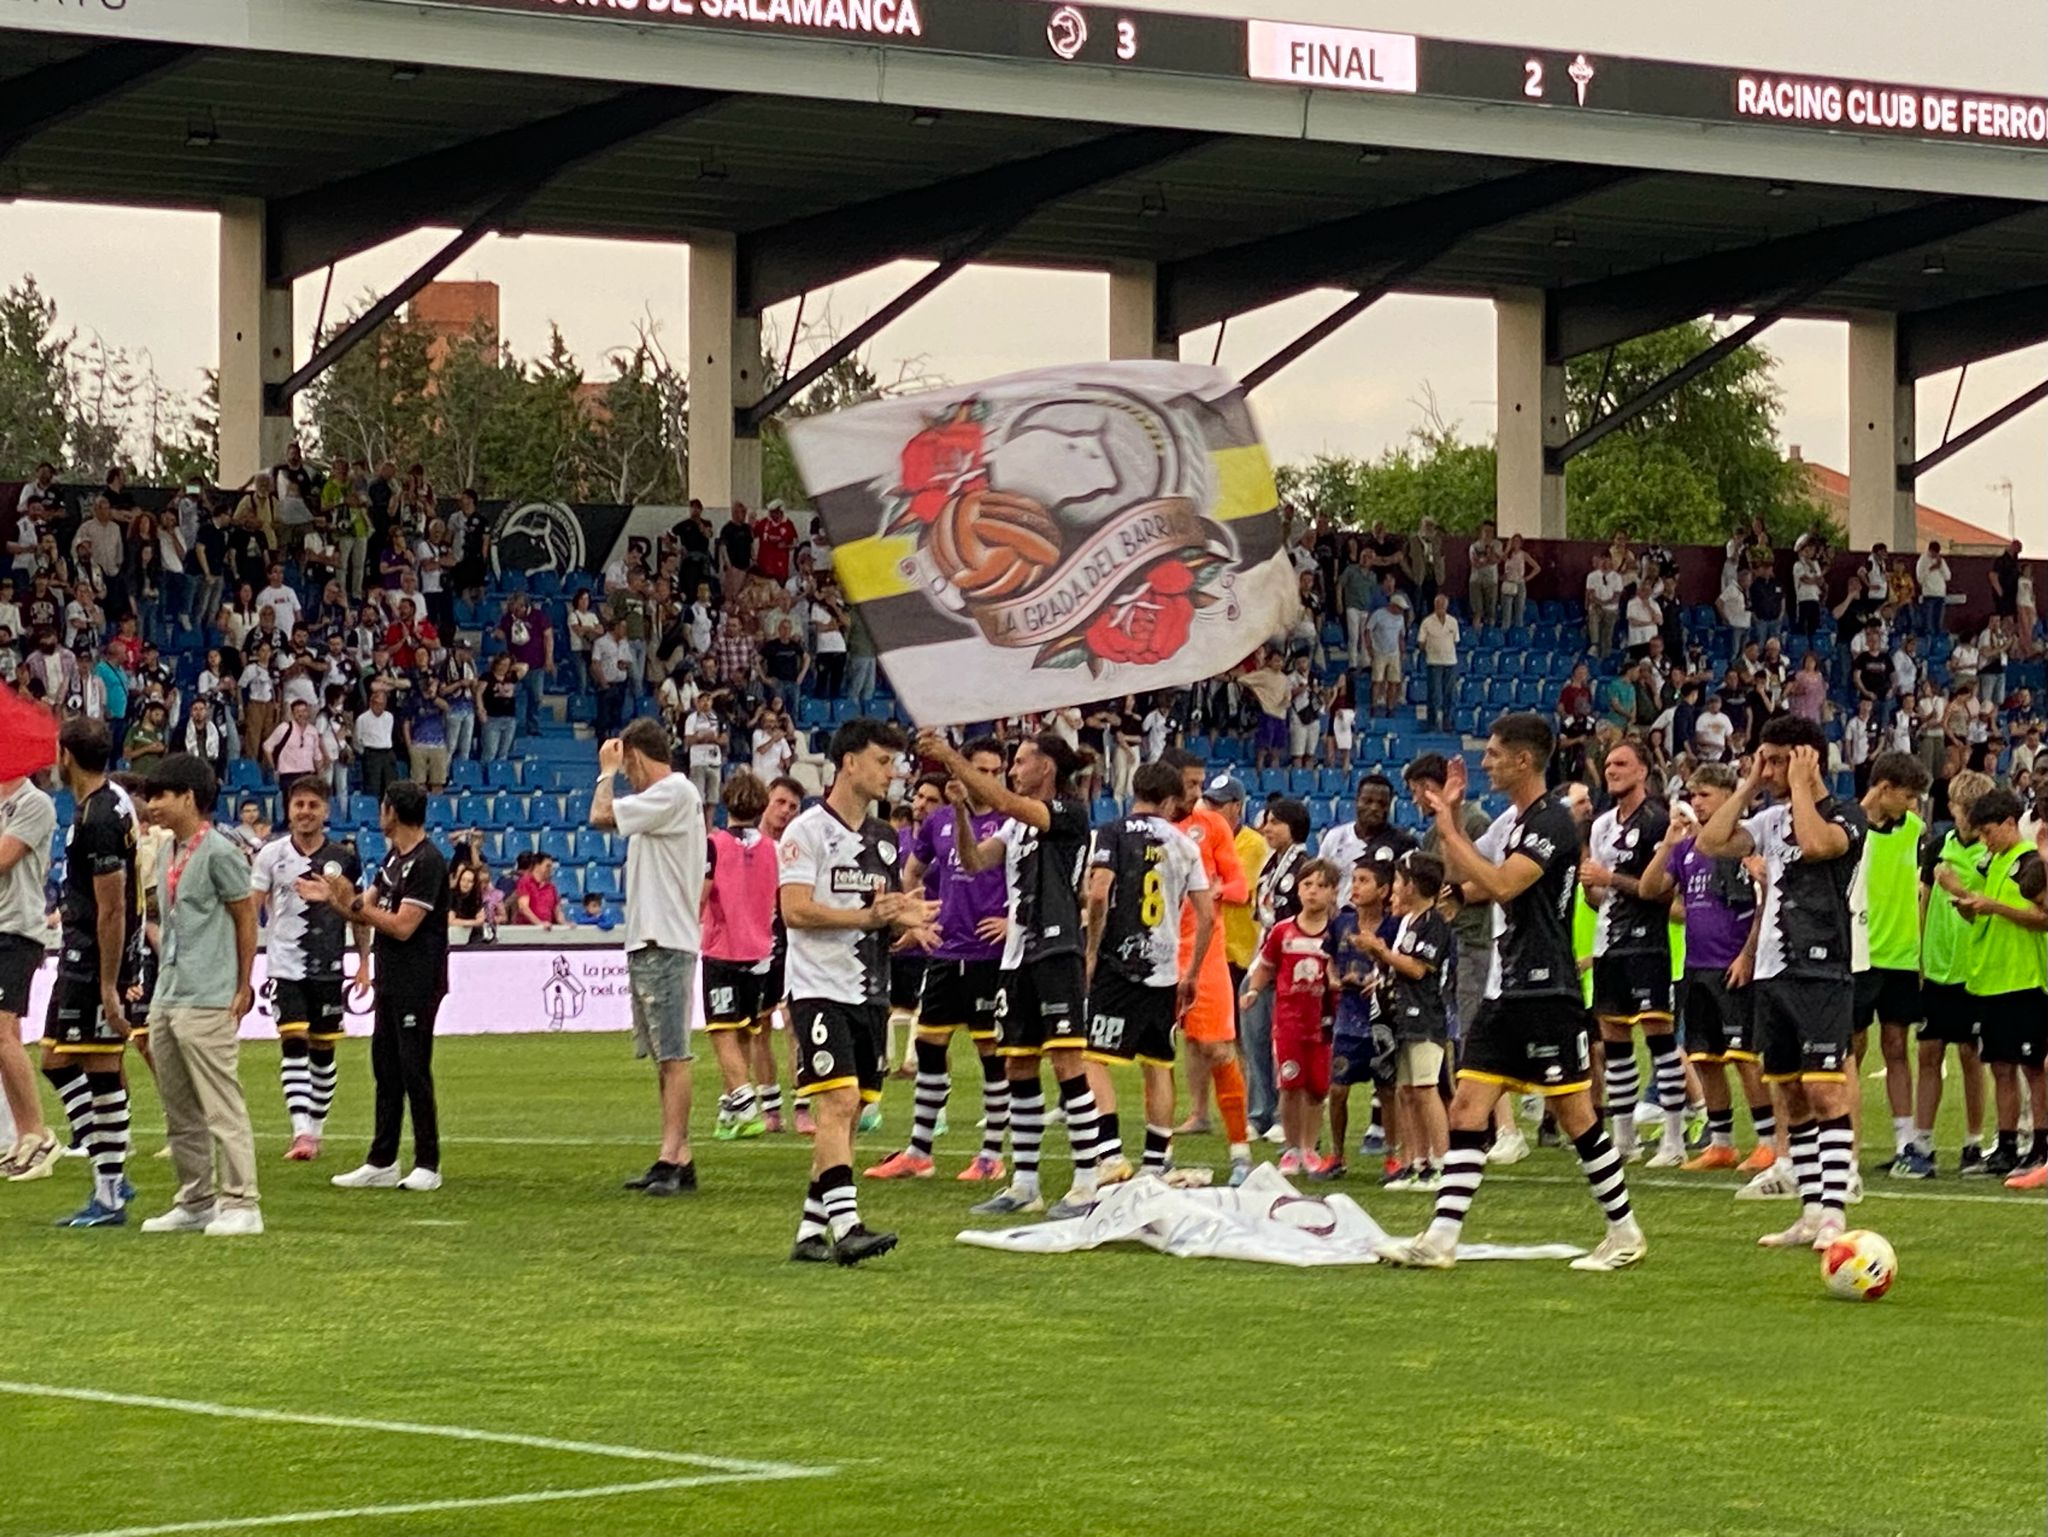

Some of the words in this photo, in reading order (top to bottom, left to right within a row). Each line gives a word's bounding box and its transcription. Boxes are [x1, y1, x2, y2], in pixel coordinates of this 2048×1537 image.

[700, 0, 921, 36] SALAMANCA
[1117, 22, 1135, 58] 3
[1290, 41, 1384, 82] FINAL
[1524, 62, 1542, 97] 2
[1738, 79, 1842, 122] RACING
[1847, 89, 1917, 128] CLUB
[1922, 97, 1958, 132] DE
[1962, 100, 2048, 141] FERRO
[1023, 578, 1091, 631] GRADA
[1084, 549, 1122, 588] DEL
[1142, 869, 1165, 927] 8
[602, 967, 630, 978] pos
[811, 1012, 829, 1046] 6
